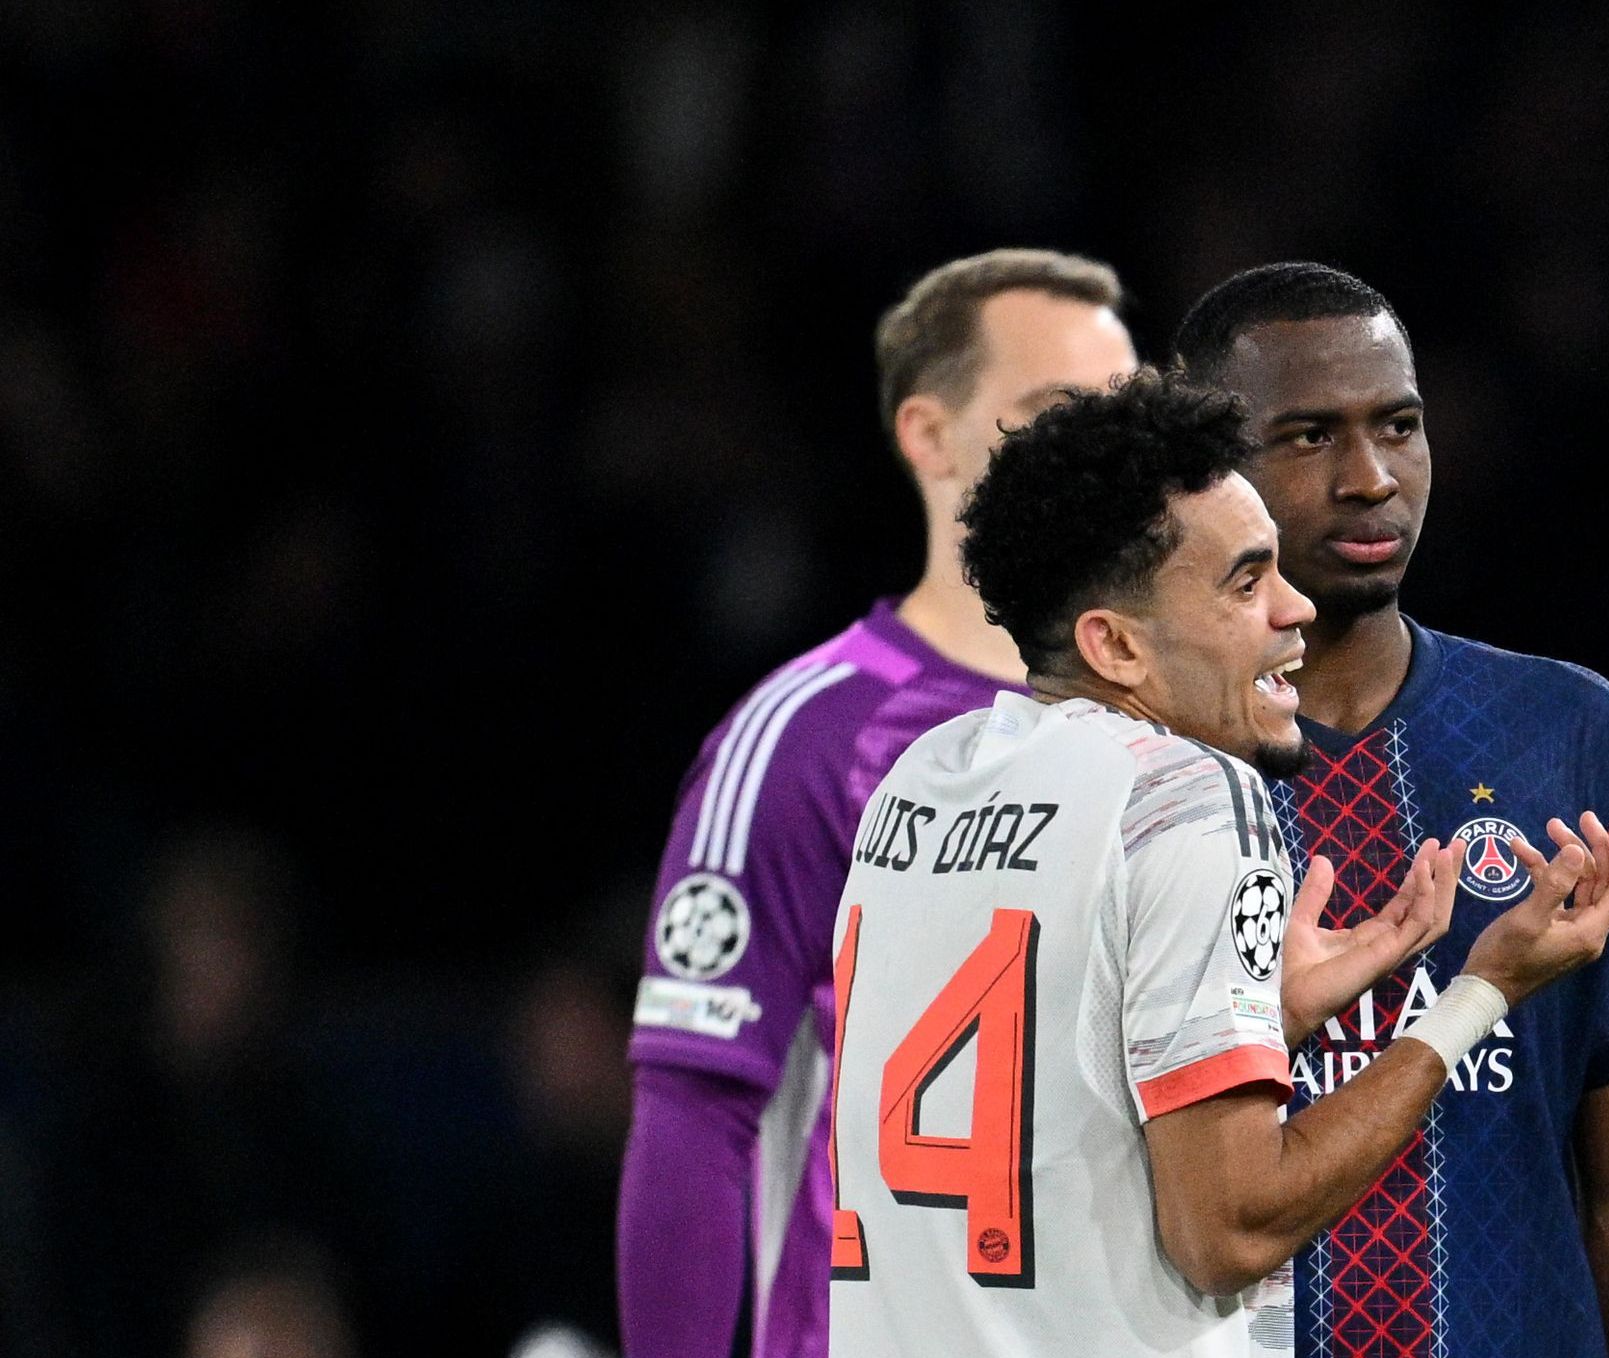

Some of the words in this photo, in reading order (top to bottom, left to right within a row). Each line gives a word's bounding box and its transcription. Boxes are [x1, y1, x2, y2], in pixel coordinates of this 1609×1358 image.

[932, 790, 1060, 874] DÍAZ
[1460, 821, 1518, 842] PARIS
[1290, 1047, 1515, 1095] AIRAYS
